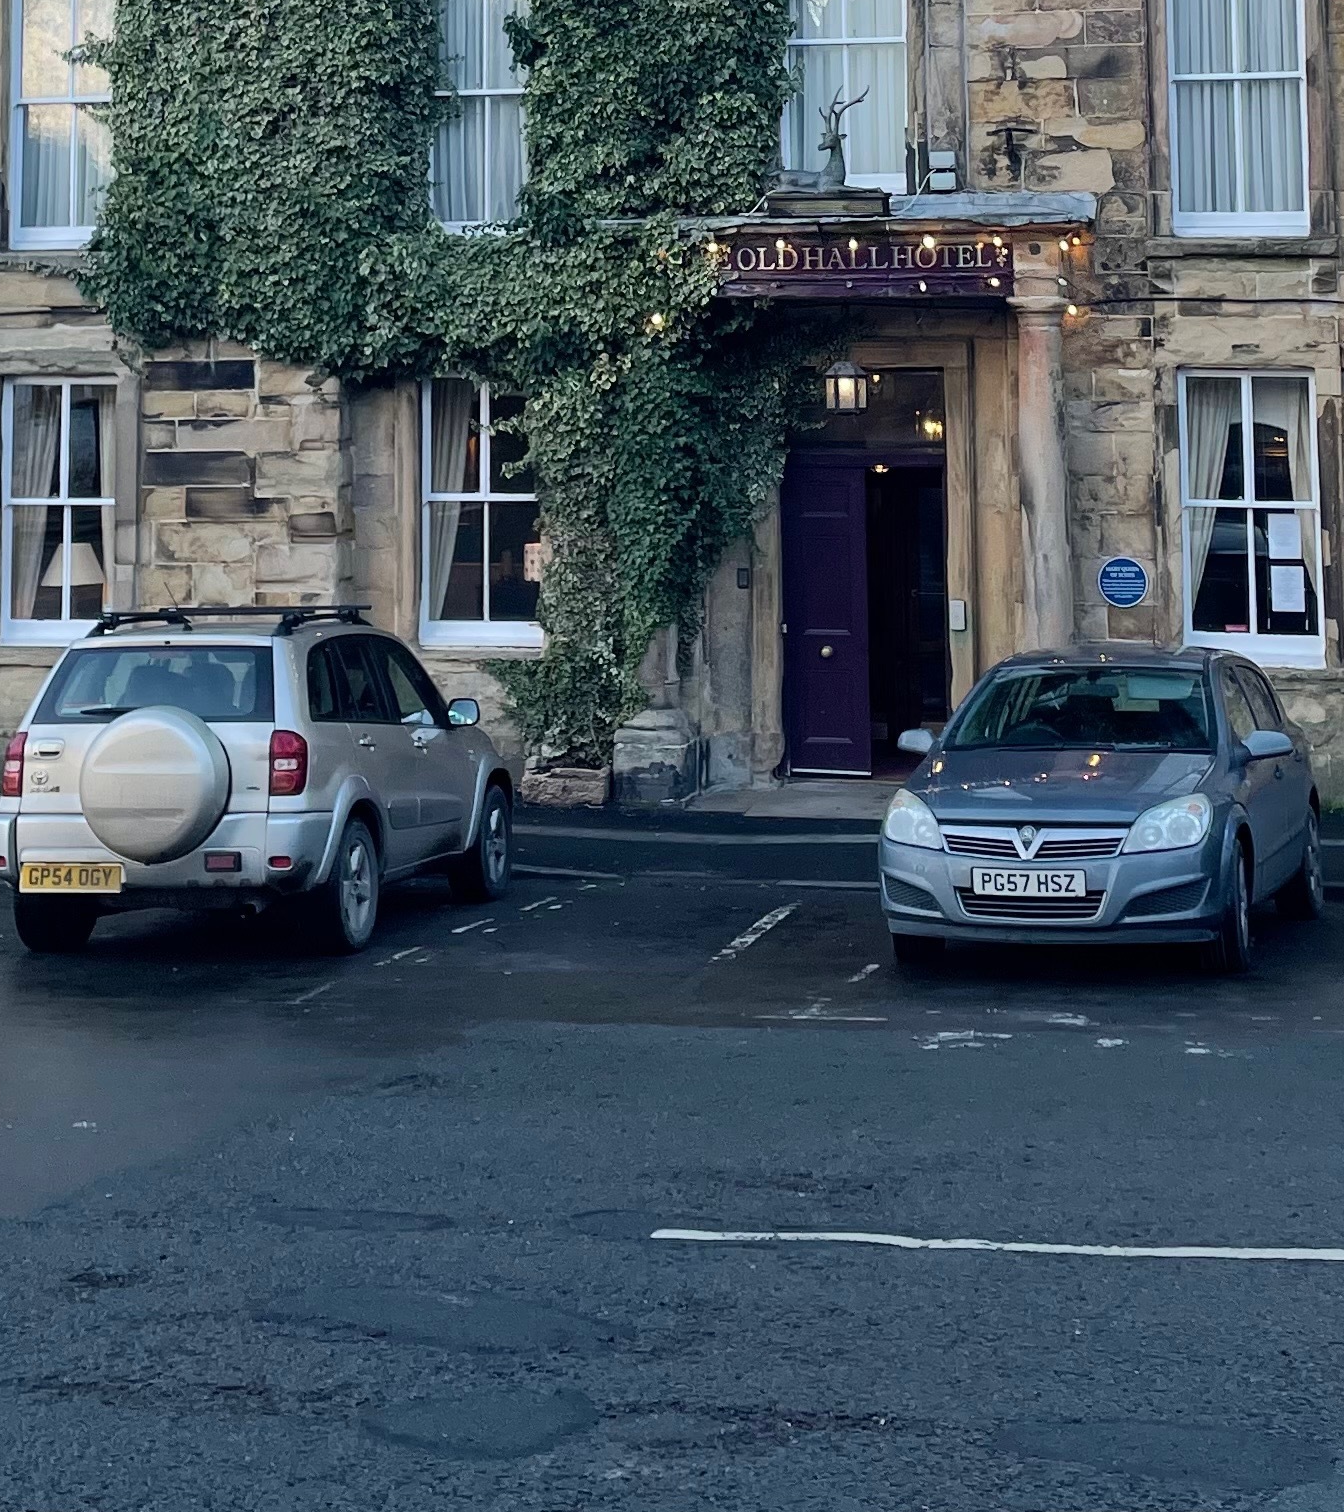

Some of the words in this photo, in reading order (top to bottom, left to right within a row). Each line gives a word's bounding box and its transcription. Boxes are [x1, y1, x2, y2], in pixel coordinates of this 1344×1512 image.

[736, 246, 799, 271] OLD
[801, 245, 888, 271] HALL
[889, 243, 992, 269] HOTEL
[28, 867, 73, 886] GP54
[78, 867, 113, 887] OGY
[981, 872, 1030, 893] PG57
[1036, 873, 1077, 893] HSZ
